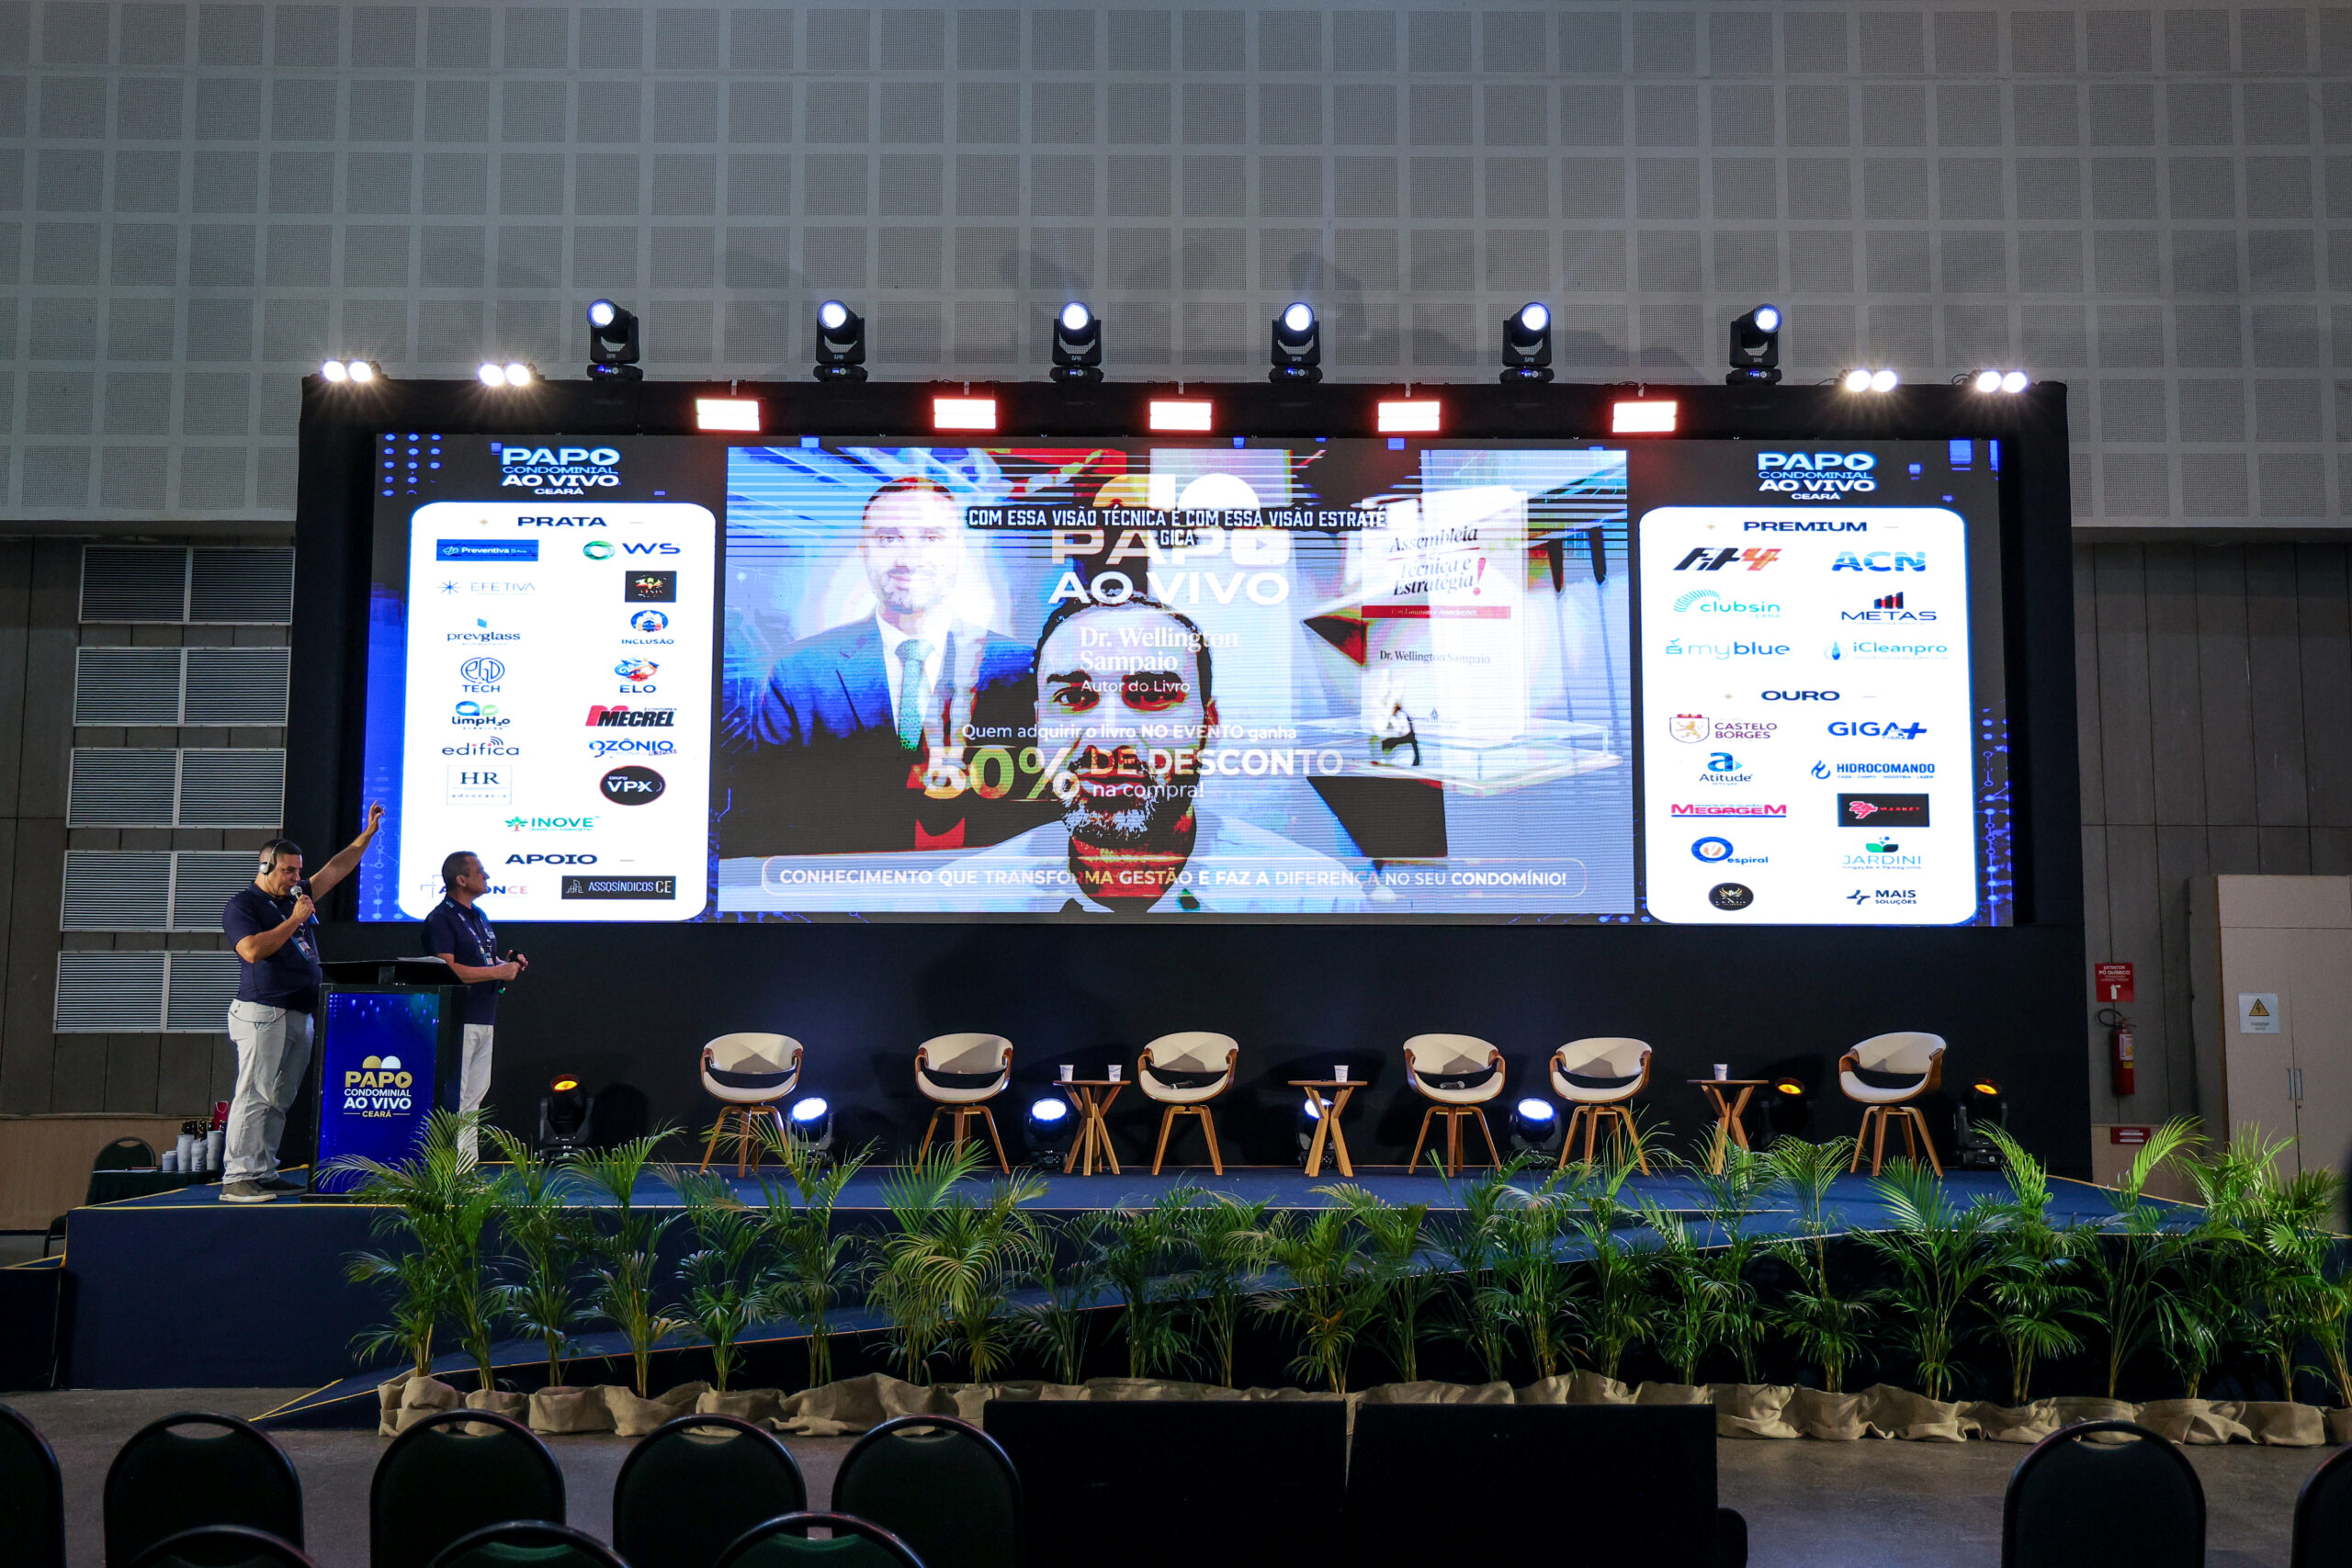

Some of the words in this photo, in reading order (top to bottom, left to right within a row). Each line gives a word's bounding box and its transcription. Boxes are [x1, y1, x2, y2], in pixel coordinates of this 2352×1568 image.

[502, 447, 620, 466] PAPO
[1757, 452, 1875, 471] PAPO
[502, 466, 619, 474] CONDOMINIAL
[1758, 471, 1874, 479] CONDOMINIAL
[502, 474, 544, 487] AO
[547, 474, 620, 487] VIVO
[1758, 479, 1800, 492] AO
[1803, 479, 1875, 492] VIVO
[534, 487, 585, 495] CEARÁ
[1791, 491, 1841, 500] CEARÁ
[517, 516, 607, 527] PRATA
[968, 509, 1003, 526] COM
[1007, 509, 1048, 526] ESSA
[1052, 504, 1098, 527] VISÃO
[1102, 503, 1167, 527] TÉCNICA
[1185, 511, 1220, 527] COM
[1224, 511, 1264, 527] ESSA
[1268, 506, 1315, 528] VISÃO
[1318, 507, 1387, 528] ESTRATÉ
[1743, 521, 1868, 532] PREMIUM
[1159, 529, 1196, 547] GICA
[1389, 525, 1479, 553] Assembleia
[621, 542, 682, 555] WS
[1831, 551, 1927, 572] ACN
[470, 581, 537, 592] EFETIVA
[1047, 570, 1135, 605] AO
[1145, 570, 1290, 606] VIVO
[1700, 601, 1781, 613] clubsin
[1841, 611, 1938, 621] METAS
[447, 631, 521, 642] prevglass
[1080, 627, 1113, 648] Dr.
[1117, 627, 1239, 653] Wellington
[1688, 641, 1791, 660] myblue
[1853, 641, 1948, 656] iCleanpro
[1080, 650, 1179, 674] Sampaio
[1380, 649, 1393, 660] Dr.
[1395, 650, 1445, 664] Wellington
[462, 684, 501, 693] TECH
[619, 684, 657, 694] ELO
[1080, 680, 1125, 693] Autor
[1128, 680, 1149, 693] do
[1153, 680, 1191, 693] Livro
[1760, 690, 1841, 702] OURO
[597, 710, 674, 728] MECREL
[962, 723, 1012, 740] Quem
[1017, 723, 1081, 741] adquirir
[1086, 728, 1097, 739] o
[1102, 724, 1136, 739] livro
[1140, 725, 1169, 739] NO
[1172, 725, 1244, 739] EVENTO
[1248, 726, 1297, 742] ganha
[1714, 730, 1771, 739] BORGES
[441, 742, 520, 756] edifica
[1091, 748, 1138, 776] DE
[1148, 748, 1344, 776] DESCONTO
[1837, 763, 1936, 773] HIDROCOMANDO
[460, 772, 500, 784] HR
[923, 746, 1080, 800] 50%
[1699, 773, 1752, 783] Atitude
[606, 781, 653, 793] VPX
[1092, 785, 1116, 797] na
[1122, 782, 1204, 801] compra!
[531, 817, 594, 828] INOVE
[505, 854, 598, 864] APOIO
[1727, 856, 1769, 865] espiral
[1842, 855, 1921, 864] JARDINI
[780, 869, 933, 884] CONHECIMENTO
[939, 870, 977, 886] QUE
[1119, 867, 1193, 885] GESTÃO
[1199, 871, 1209, 885] E
[1216, 871, 1250, 885] FAZ
[1256, 871, 1270, 885] A
[1385, 873, 1409, 885] NO
[1415, 873, 1445, 885] SEU
[1451, 869, 1566, 886] CONDOMÍNIO!
[588, 880, 654, 893] ASSOSÍNDICOS
[655, 881, 672, 894] CE
[1875, 889, 1917, 898] MAIS
[345, 1071, 413, 1089] PAPO
[344, 1089, 412, 1097] CONDOMINIAL
[344, 1097, 368, 1109] AO
[371, 1098, 412, 1110] VIVO
[362, 1110, 392, 1118] CEARÁ
